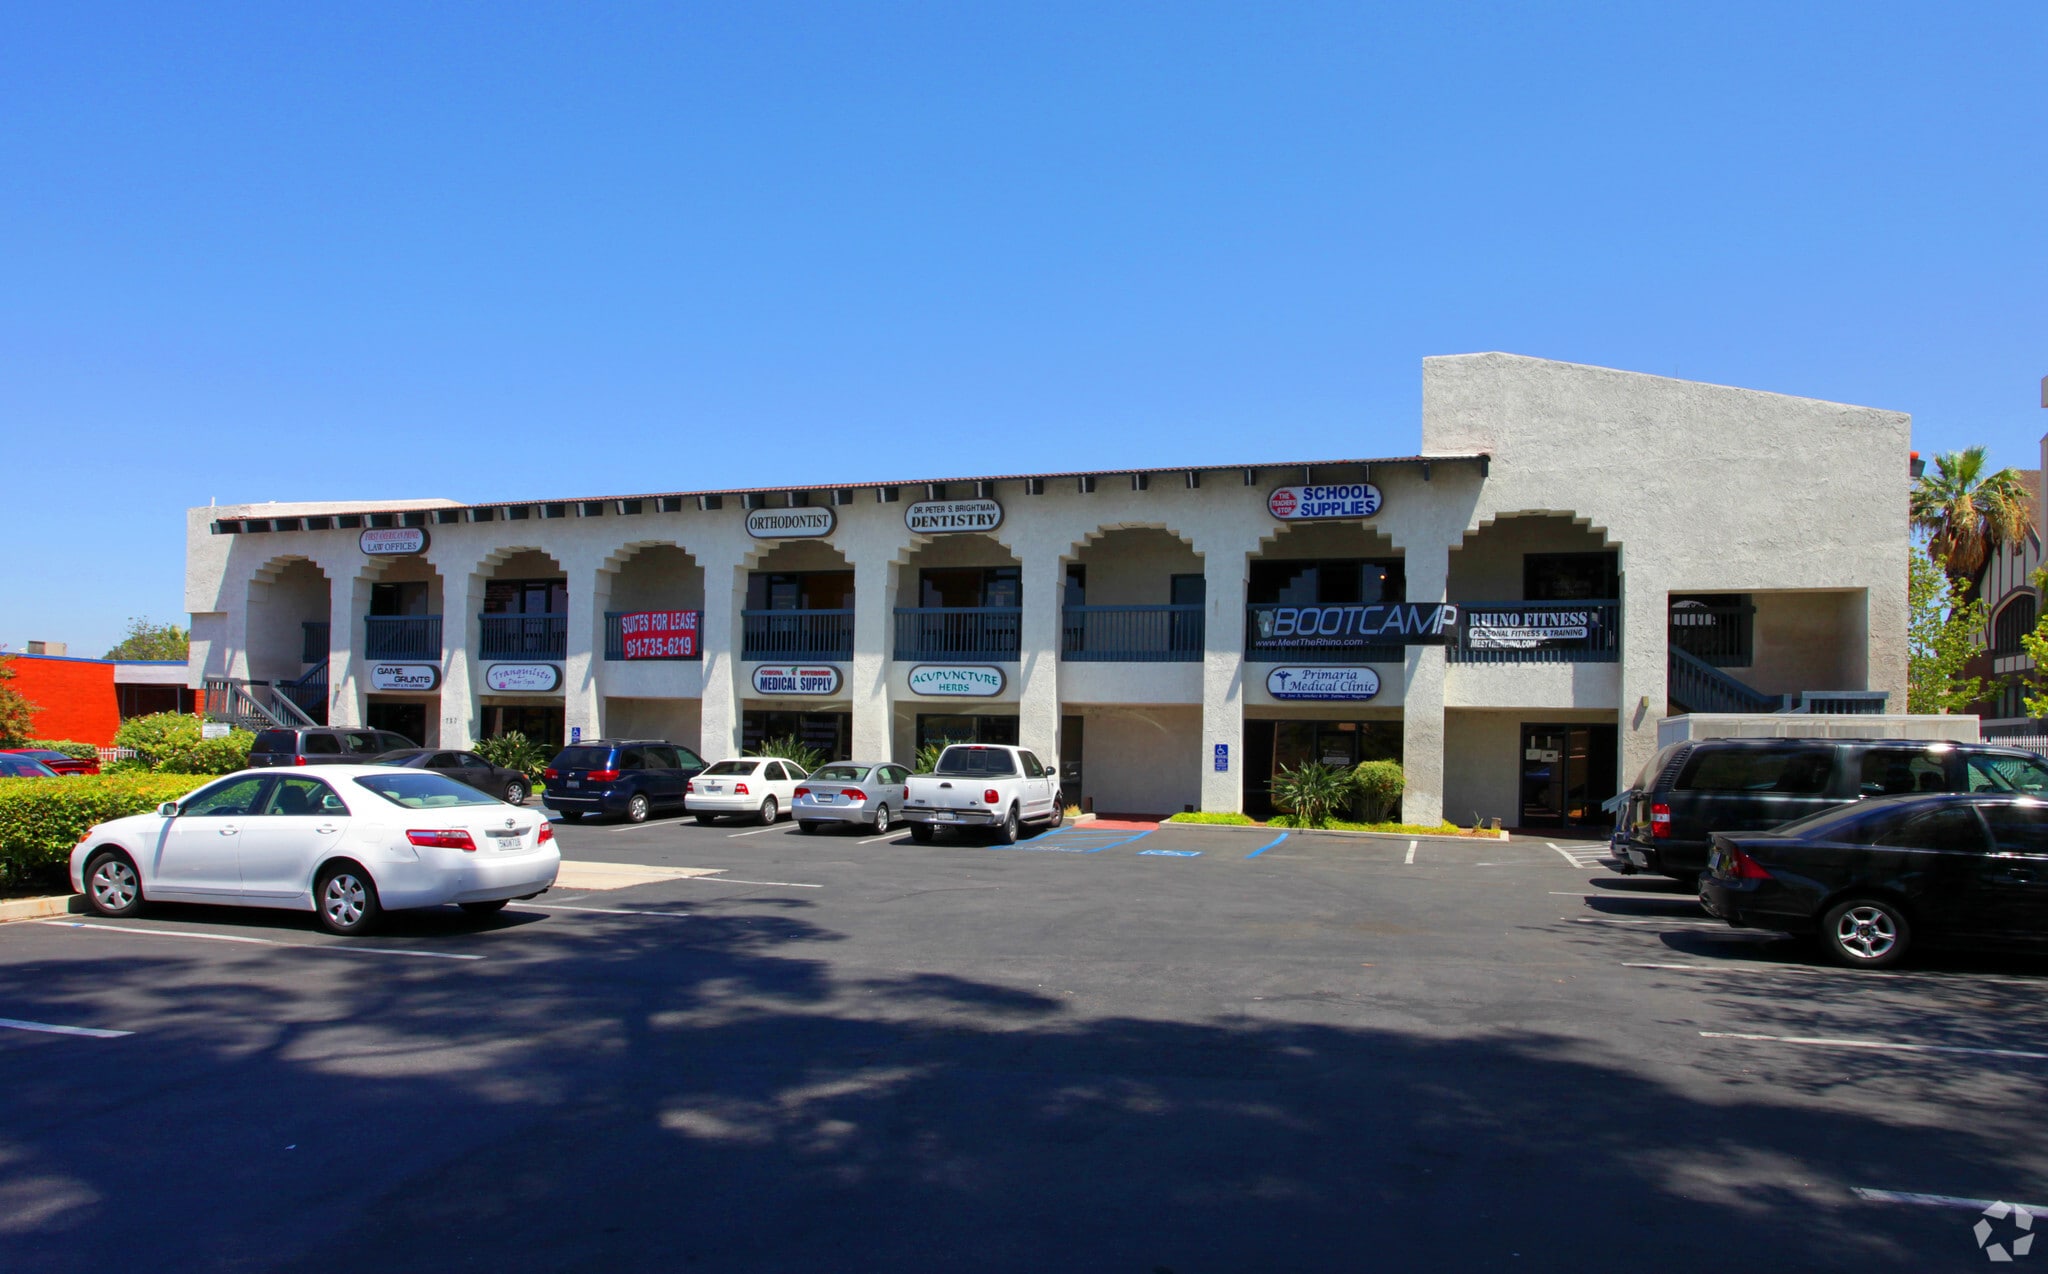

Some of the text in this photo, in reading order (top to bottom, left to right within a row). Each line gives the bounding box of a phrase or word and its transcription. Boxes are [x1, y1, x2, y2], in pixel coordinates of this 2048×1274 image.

[1303, 485, 1375, 501] SCHOOL
[914, 503, 995, 514] DR. PETER S. BRIGHTMAN
[1300, 500, 1376, 516] SUPPLIES
[750, 514, 829, 530] ORTHODONTIST
[911, 513, 997, 528] DENTISTRY
[367, 542, 417, 552] LAW OFFICES
[622, 611, 697, 634] SUITES FOR LEASE
[1273, 605, 1458, 635] BOOTCAMP
[1469, 611, 1588, 627] RHINO FITNESS
[1473, 628, 1583, 637] PERSONAL FITNESS & TRAINING
[1255, 638, 1364, 647] www.MeetTheRhino.com
[377, 667, 403, 675] GAME
[493, 667, 551, 684] Tranquility
[1302, 669, 1357, 680] Primaria
[394, 675, 431, 683] GRUNTS
[522, 679, 536, 687] Spa
[760, 677, 833, 691] MEDICAL SUPPLY
[912, 670, 999, 686] ACUPUNCTURE
[938, 683, 970, 692] HERBS
[1288, 680, 1376, 692] Medical Clinic
